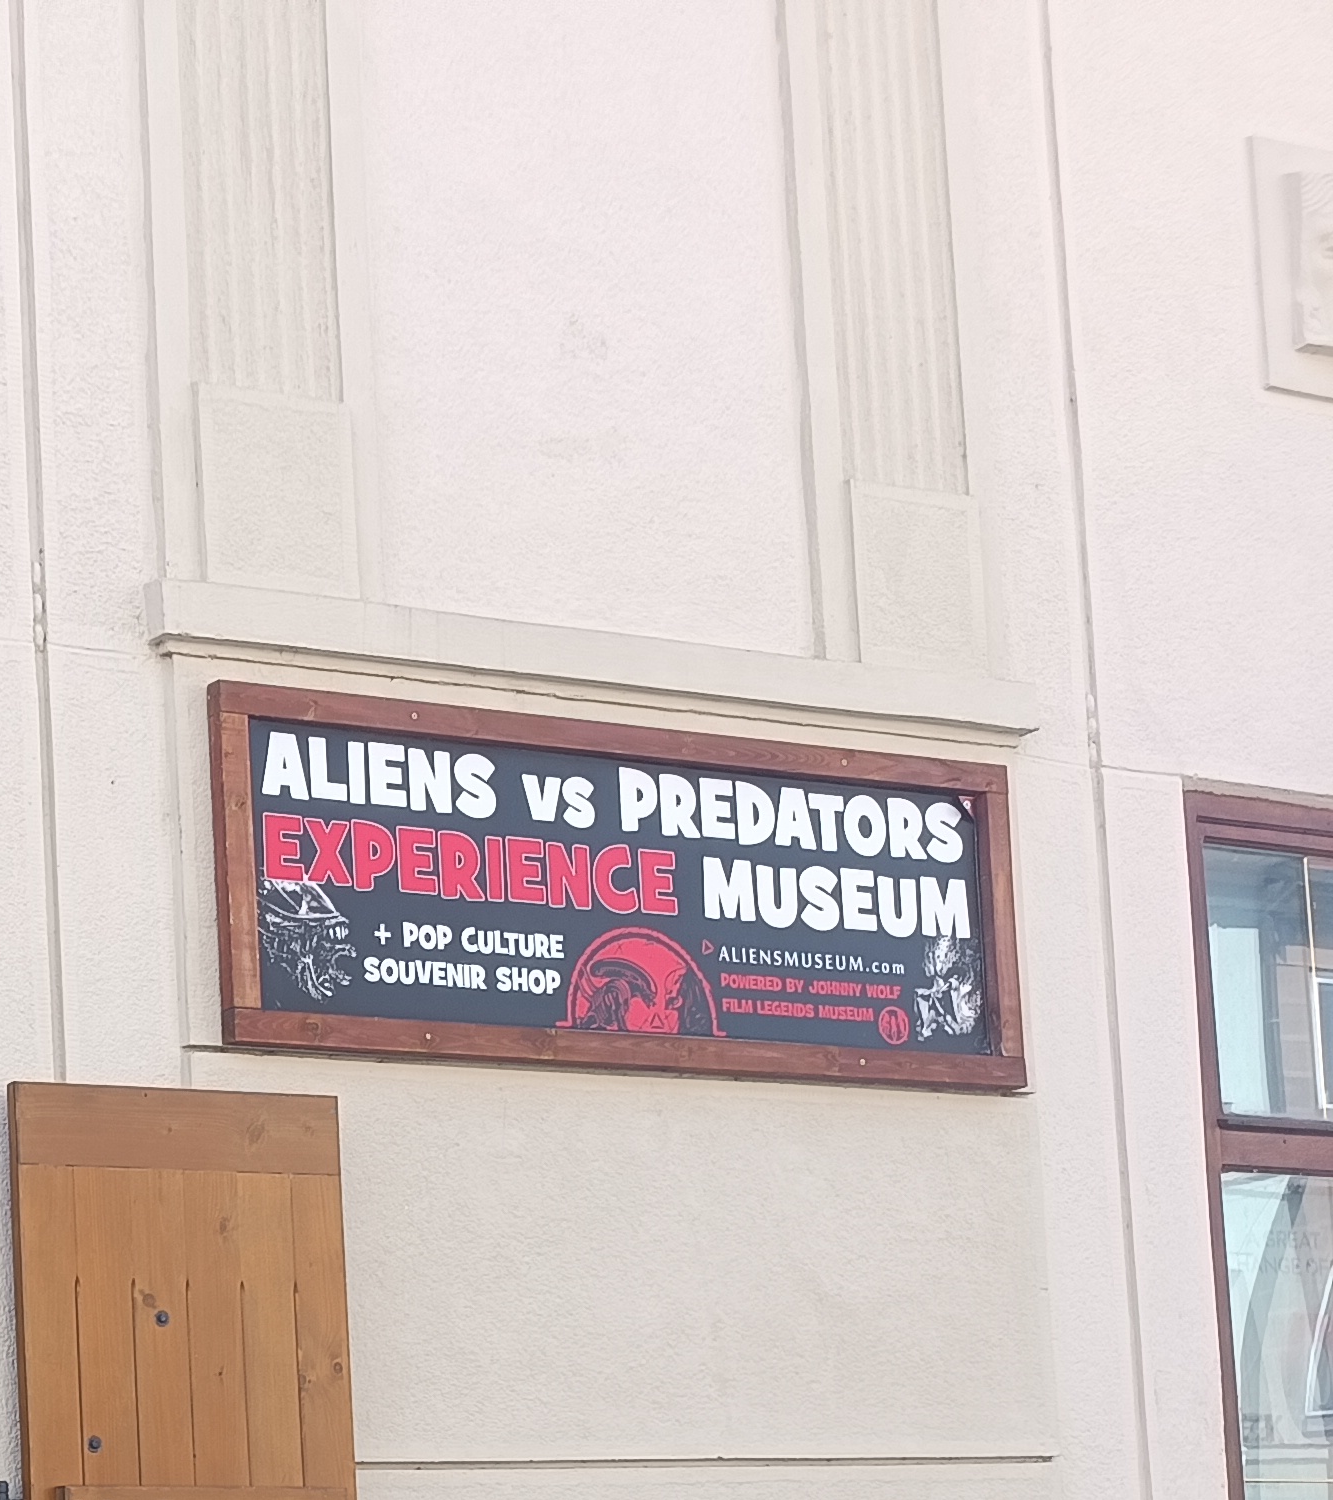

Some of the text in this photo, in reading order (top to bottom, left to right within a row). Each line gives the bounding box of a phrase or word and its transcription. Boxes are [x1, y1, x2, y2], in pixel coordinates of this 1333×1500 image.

[262, 731, 497, 818] ALIENS
[618, 766, 964, 864] PREDATORS
[261, 812, 972, 939] EXPERIENCE MUSEUM
[403, 921, 453, 956] POP
[460, 925, 564, 960] CULTURE
[718, 946, 905, 974] ALIENSMUSEUM.com
[364, 956, 561, 996] SOUVENIR SHOP
[721, 972, 902, 999] POWERED BY JOHNNY WOLF
[722, 997, 874, 1022] FILM LEGENDS MUSEUM
